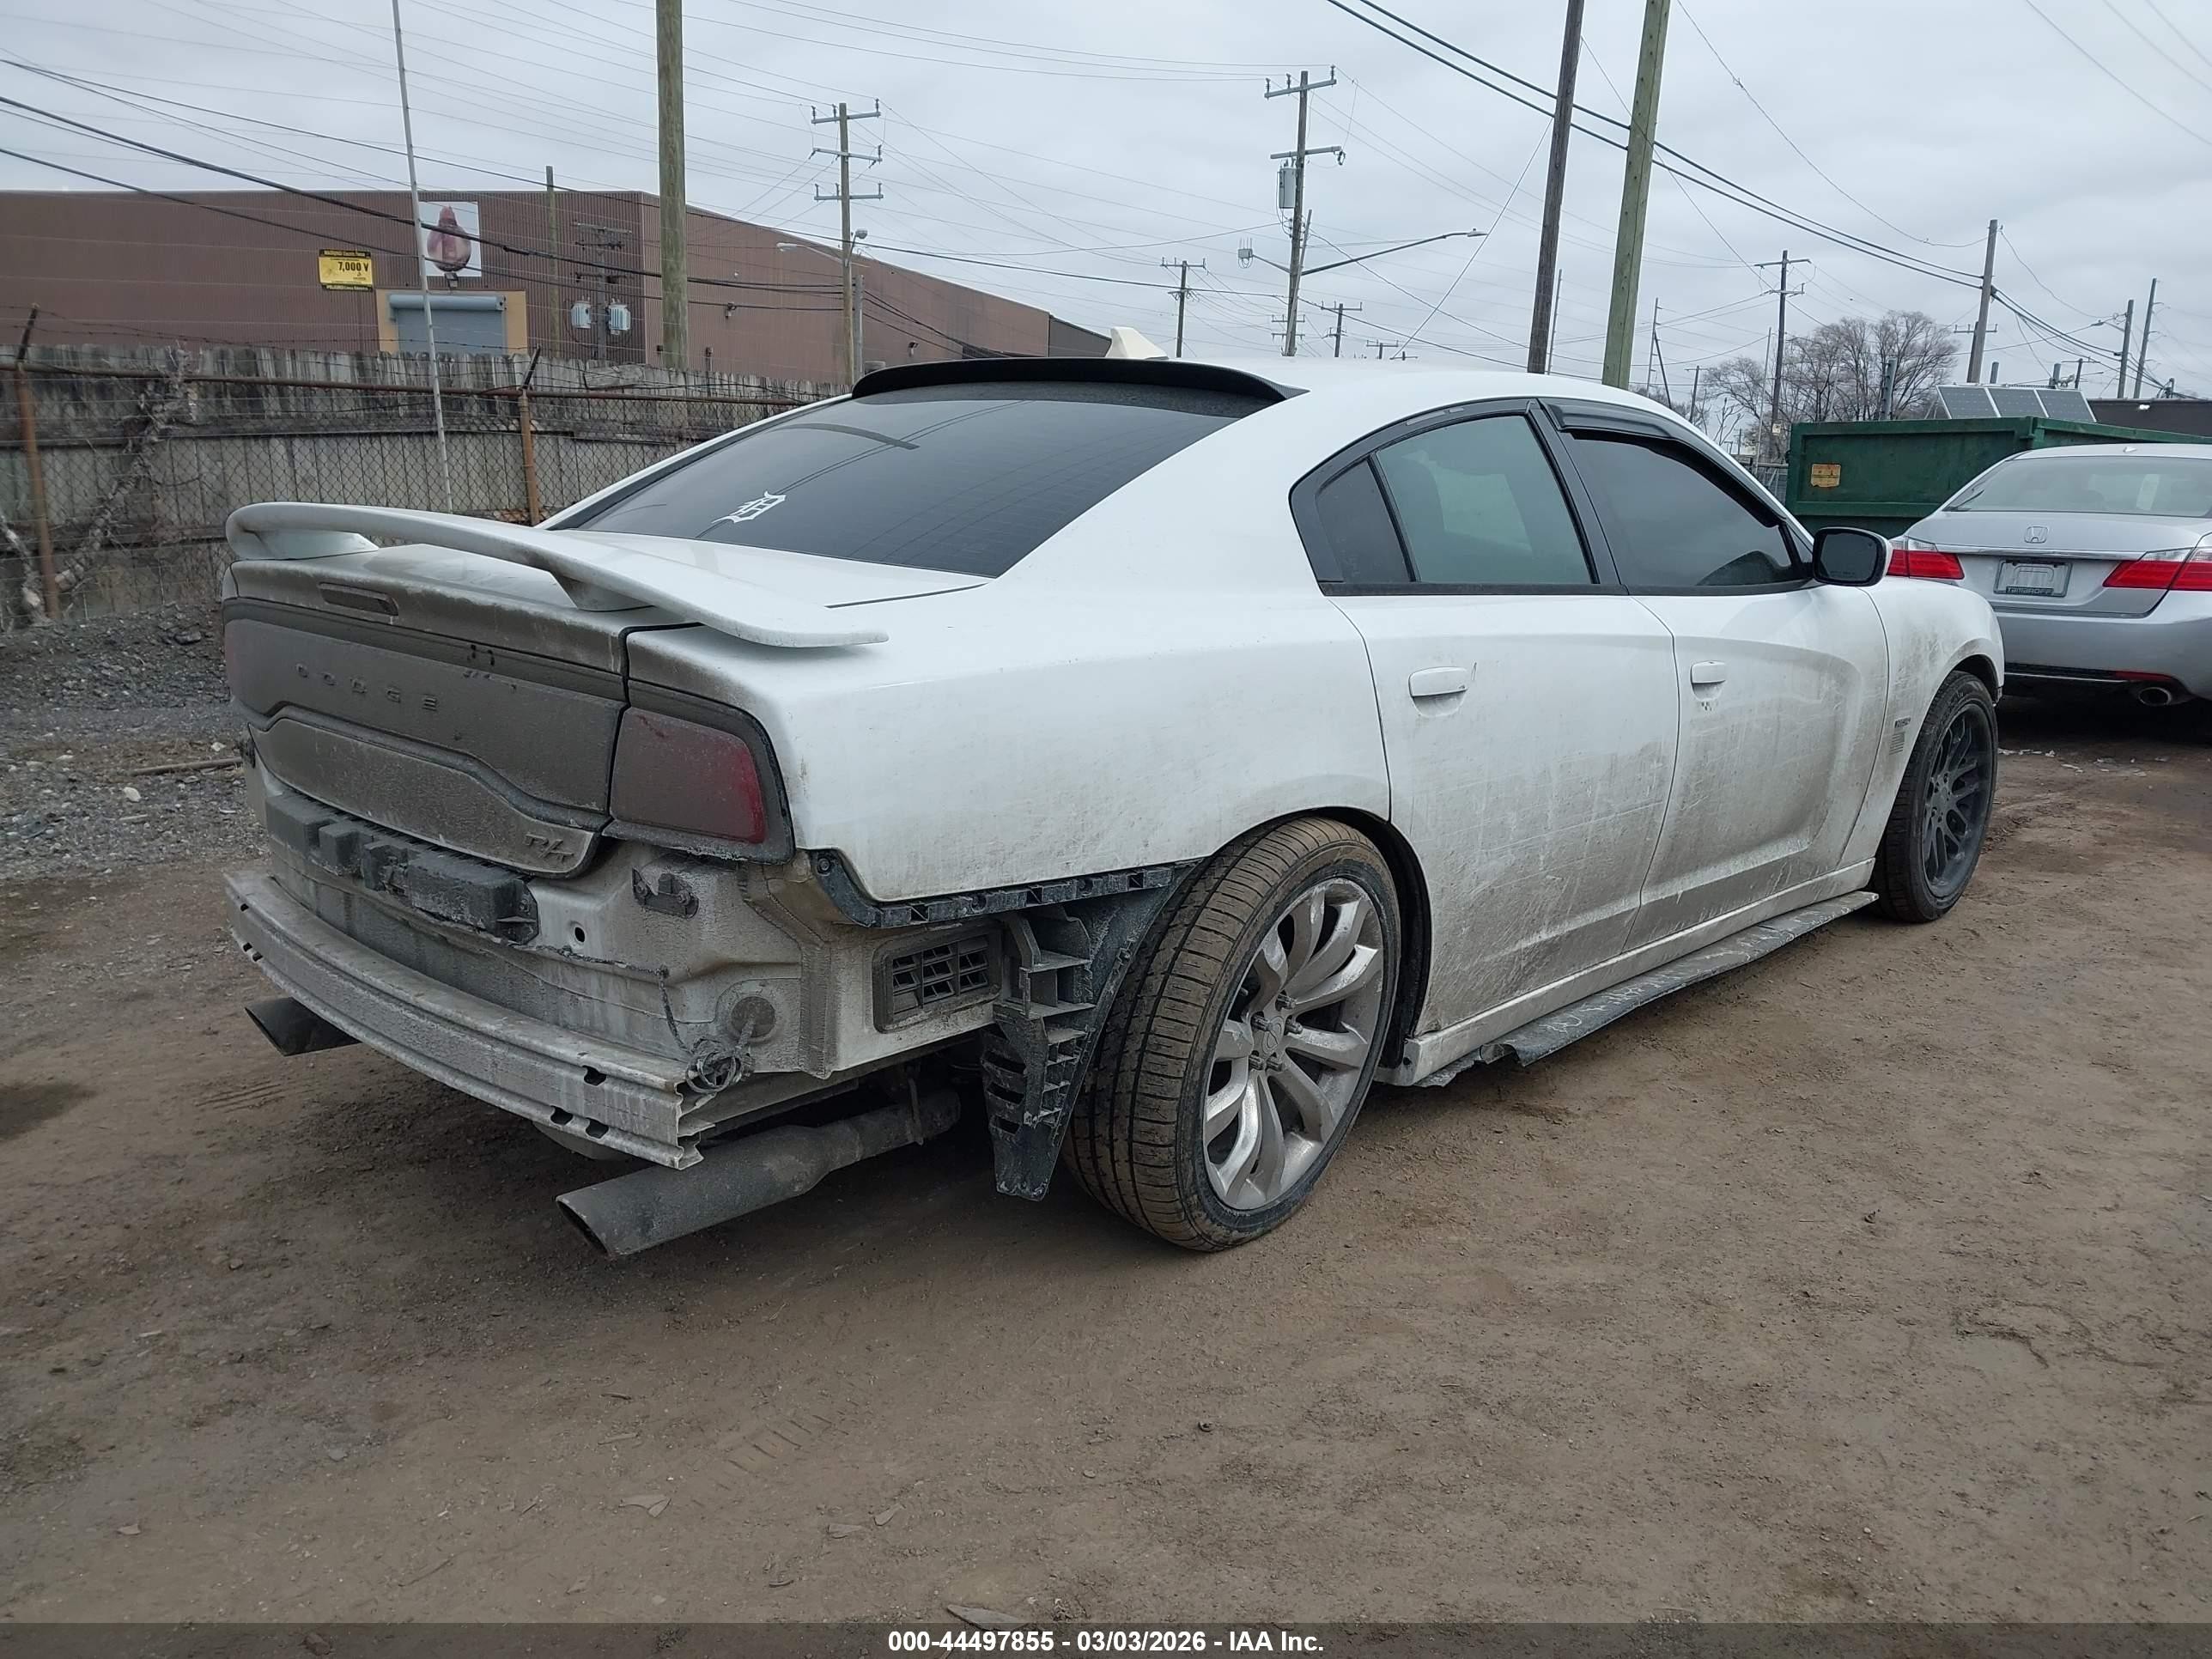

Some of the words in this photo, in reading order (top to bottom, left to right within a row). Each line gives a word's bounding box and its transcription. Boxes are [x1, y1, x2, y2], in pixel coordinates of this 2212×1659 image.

[337, 261, 362, 272] 7,000
[363, 262, 369, 272] V
[295, 663, 438, 711] DODGE
[522, 832, 574, 863] R/T
